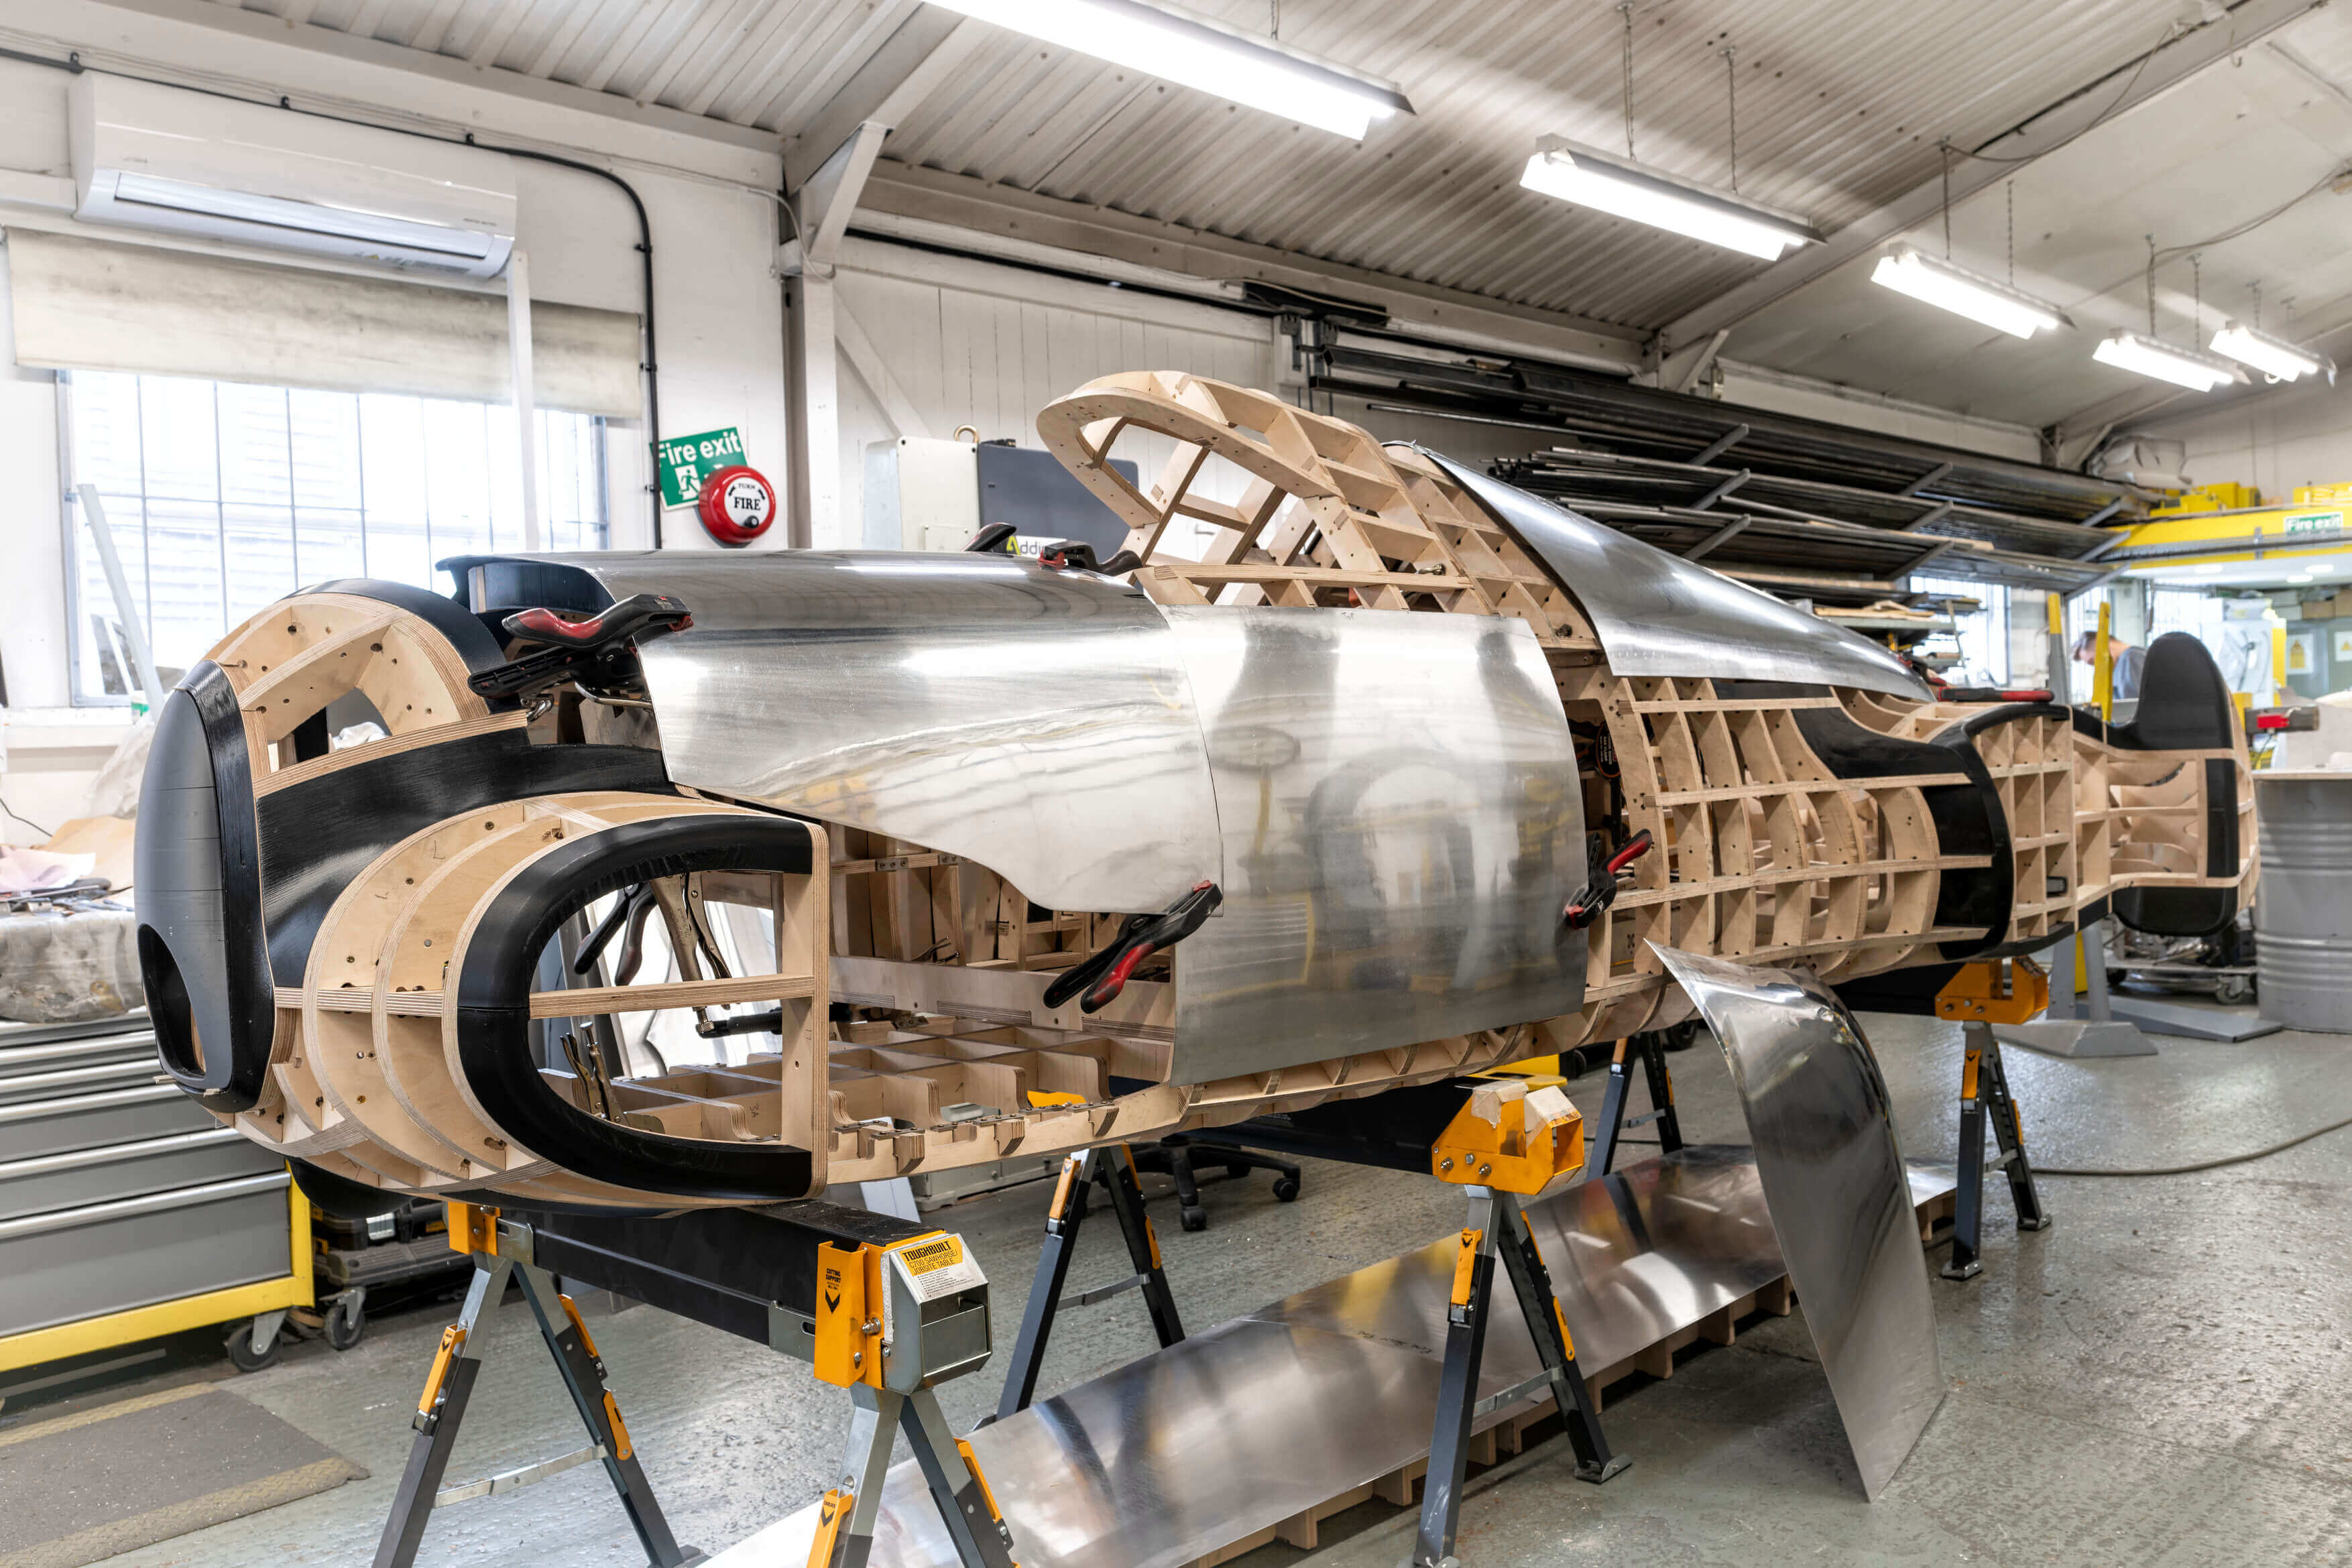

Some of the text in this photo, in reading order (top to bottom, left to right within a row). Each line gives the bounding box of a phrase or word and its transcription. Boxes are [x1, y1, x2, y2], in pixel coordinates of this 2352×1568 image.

[658, 431, 742, 467] Fire exit
[734, 496, 761, 511] FIRE
[2287, 514, 2341, 532] Fire exit
[1006, 536, 1045, 556] Addi
[902, 1241, 951, 1261] TOUGHBUILT
[908, 1259, 925, 1269] C700
[913, 1258, 955, 1275] JOBSITE TABLE
